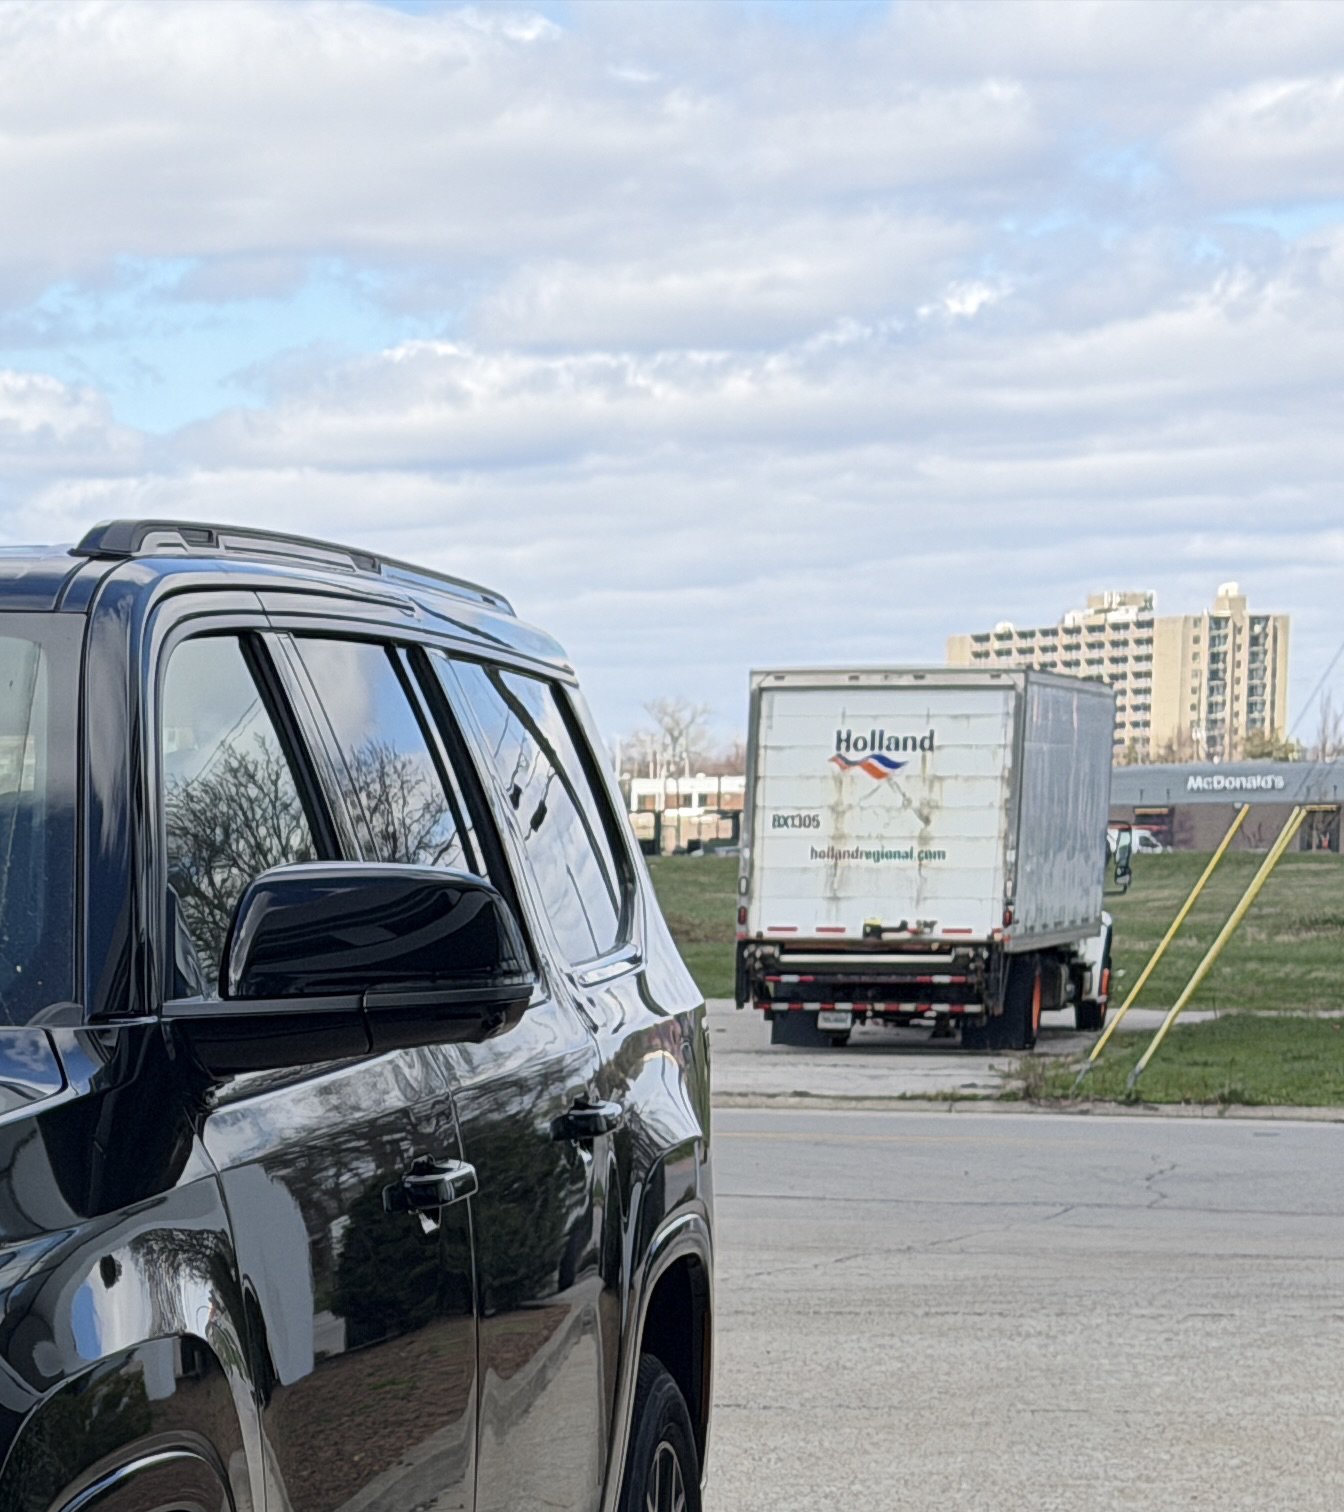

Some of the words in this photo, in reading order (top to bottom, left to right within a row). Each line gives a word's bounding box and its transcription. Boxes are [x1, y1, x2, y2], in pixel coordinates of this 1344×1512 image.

[835, 728, 935, 753] Holland
[1186, 774, 1285, 791] McDonald's
[809, 844, 947, 863] hollandregional.com
